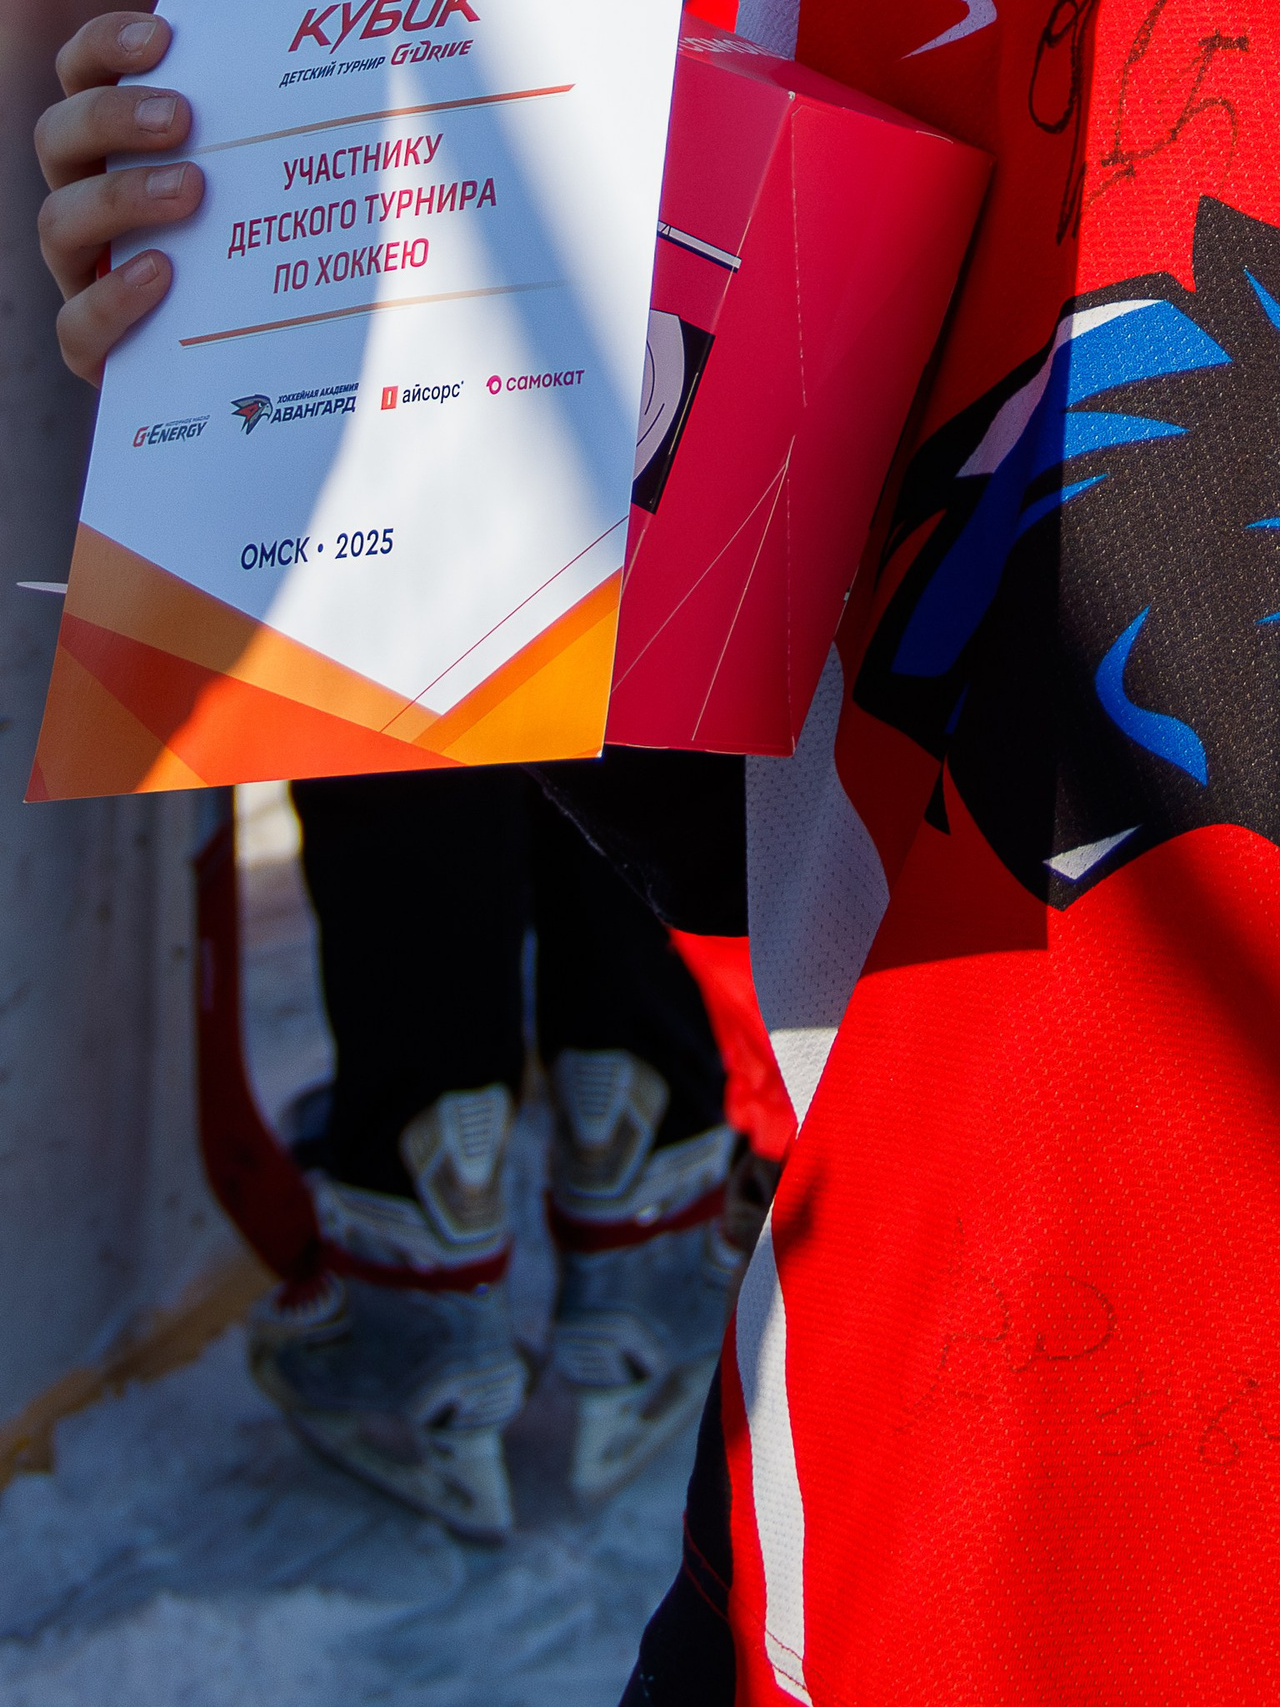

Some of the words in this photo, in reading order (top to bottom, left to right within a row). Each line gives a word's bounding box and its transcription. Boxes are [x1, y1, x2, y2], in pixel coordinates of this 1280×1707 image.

[279, 61, 337, 88] ДЕТСКИЙ
[337, 56, 386, 76] ТУРНИР
[283, 133, 444, 191] УЧАСТНИКУ
[227, 198, 357, 260] ДЕТСКОГО
[364, 177, 497, 225] ТУРНИРА
[272, 259, 309, 294] ПО
[314, 237, 430, 287] ХОККЕЮ
[277, 387, 320, 404] ХОККЕЙНАЯ
[319, 382, 359, 398] АКАДЕМИЯ
[506, 369, 586, 392] самокат
[270, 395, 357, 424] АВАНГАРД
[241, 536, 311, 570] ОМСК
[334, 527, 395, 560] 2025
